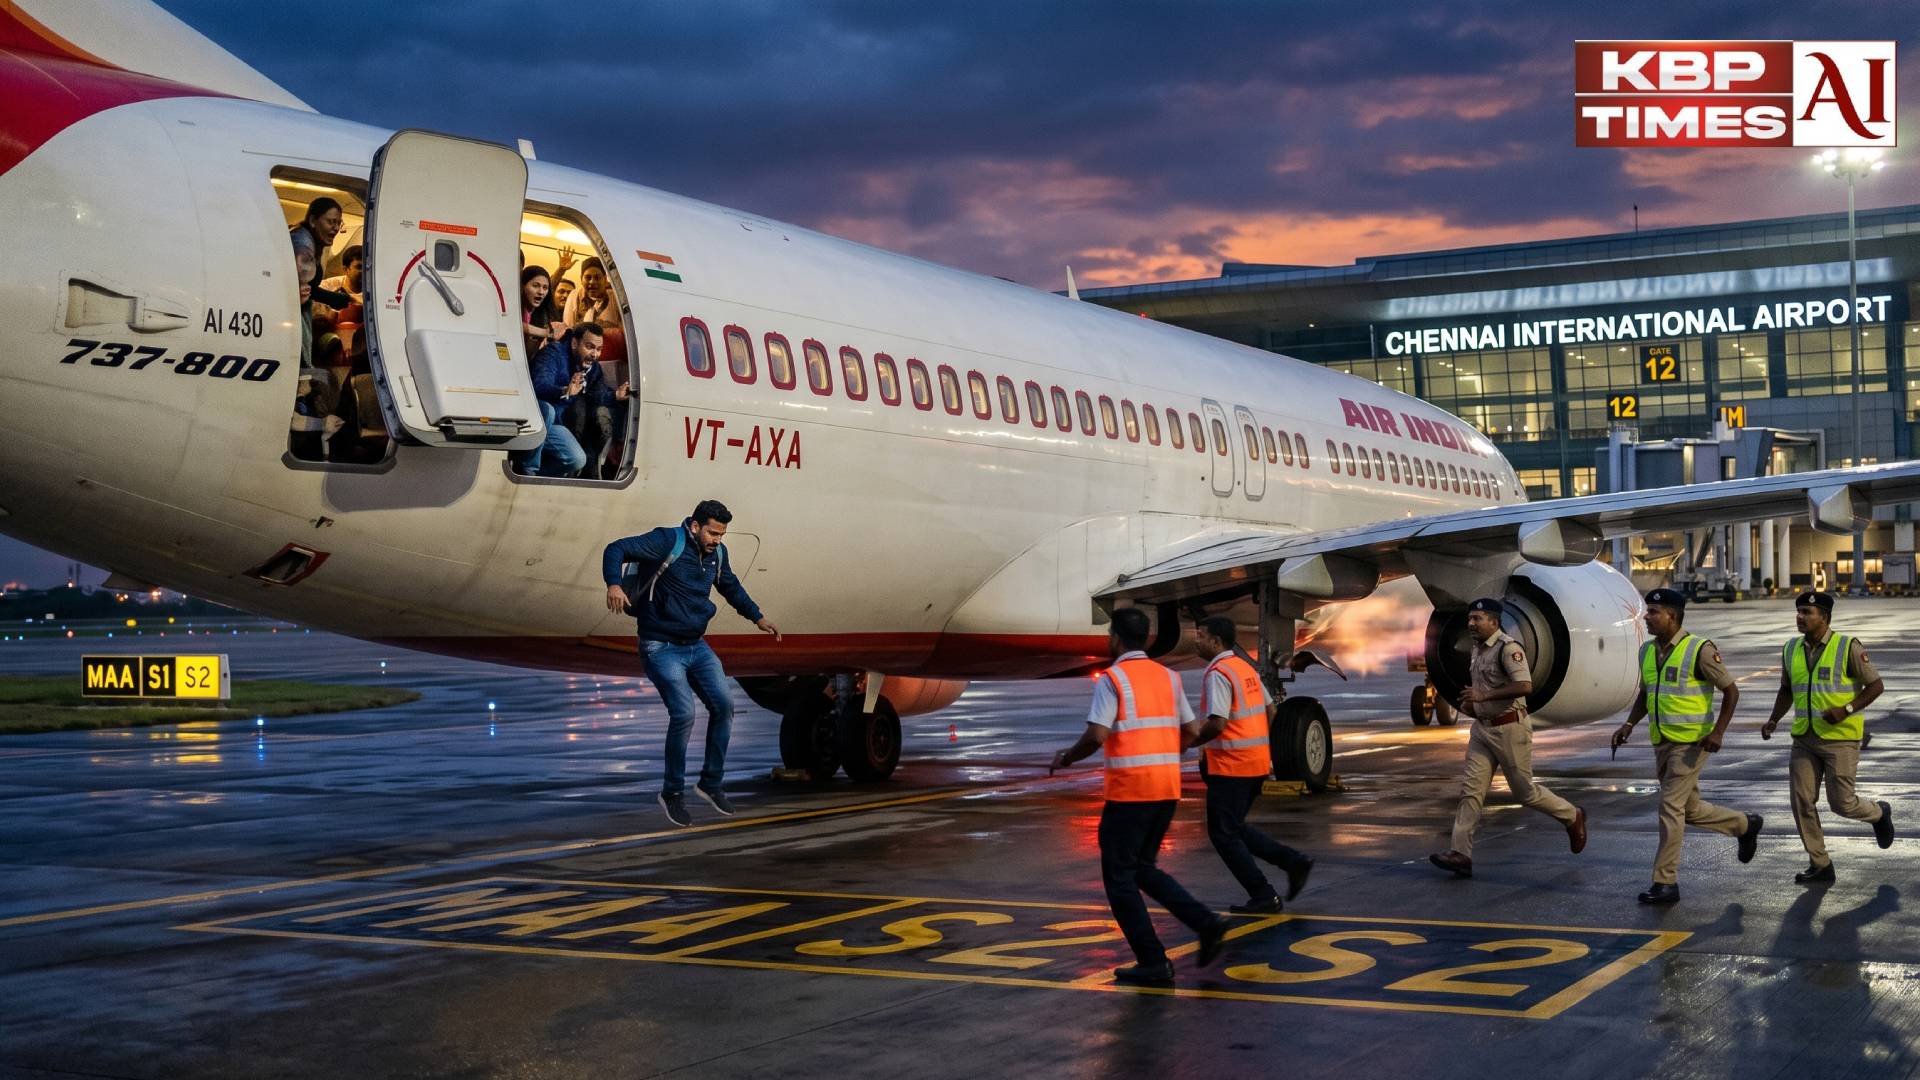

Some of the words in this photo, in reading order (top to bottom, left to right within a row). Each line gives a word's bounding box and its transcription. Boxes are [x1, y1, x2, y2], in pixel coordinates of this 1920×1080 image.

[204, 307, 222, 334] AI
[228, 311, 263, 338] 430
[1385, 323, 1505, 355] CHENNAI
[1513, 306, 1746, 347] INTERNATIONAL
[1752, 295, 1892, 330] AIRPORT
[60, 338, 281, 382] 737-800
[1645, 355, 1676, 380] 12
[1339, 398, 1402, 438] AIR
[1399, 412, 1488, 460] INDI
[1609, 396, 1636, 418] 12
[684, 416, 801, 470] VT-AXA
[87, 664, 134, 689] MAA
[148, 664, 170, 689] S1
[185, 666, 210, 688] S2
[795, 911, 1124, 970] S2
[1224, 930, 1591, 997] S2
